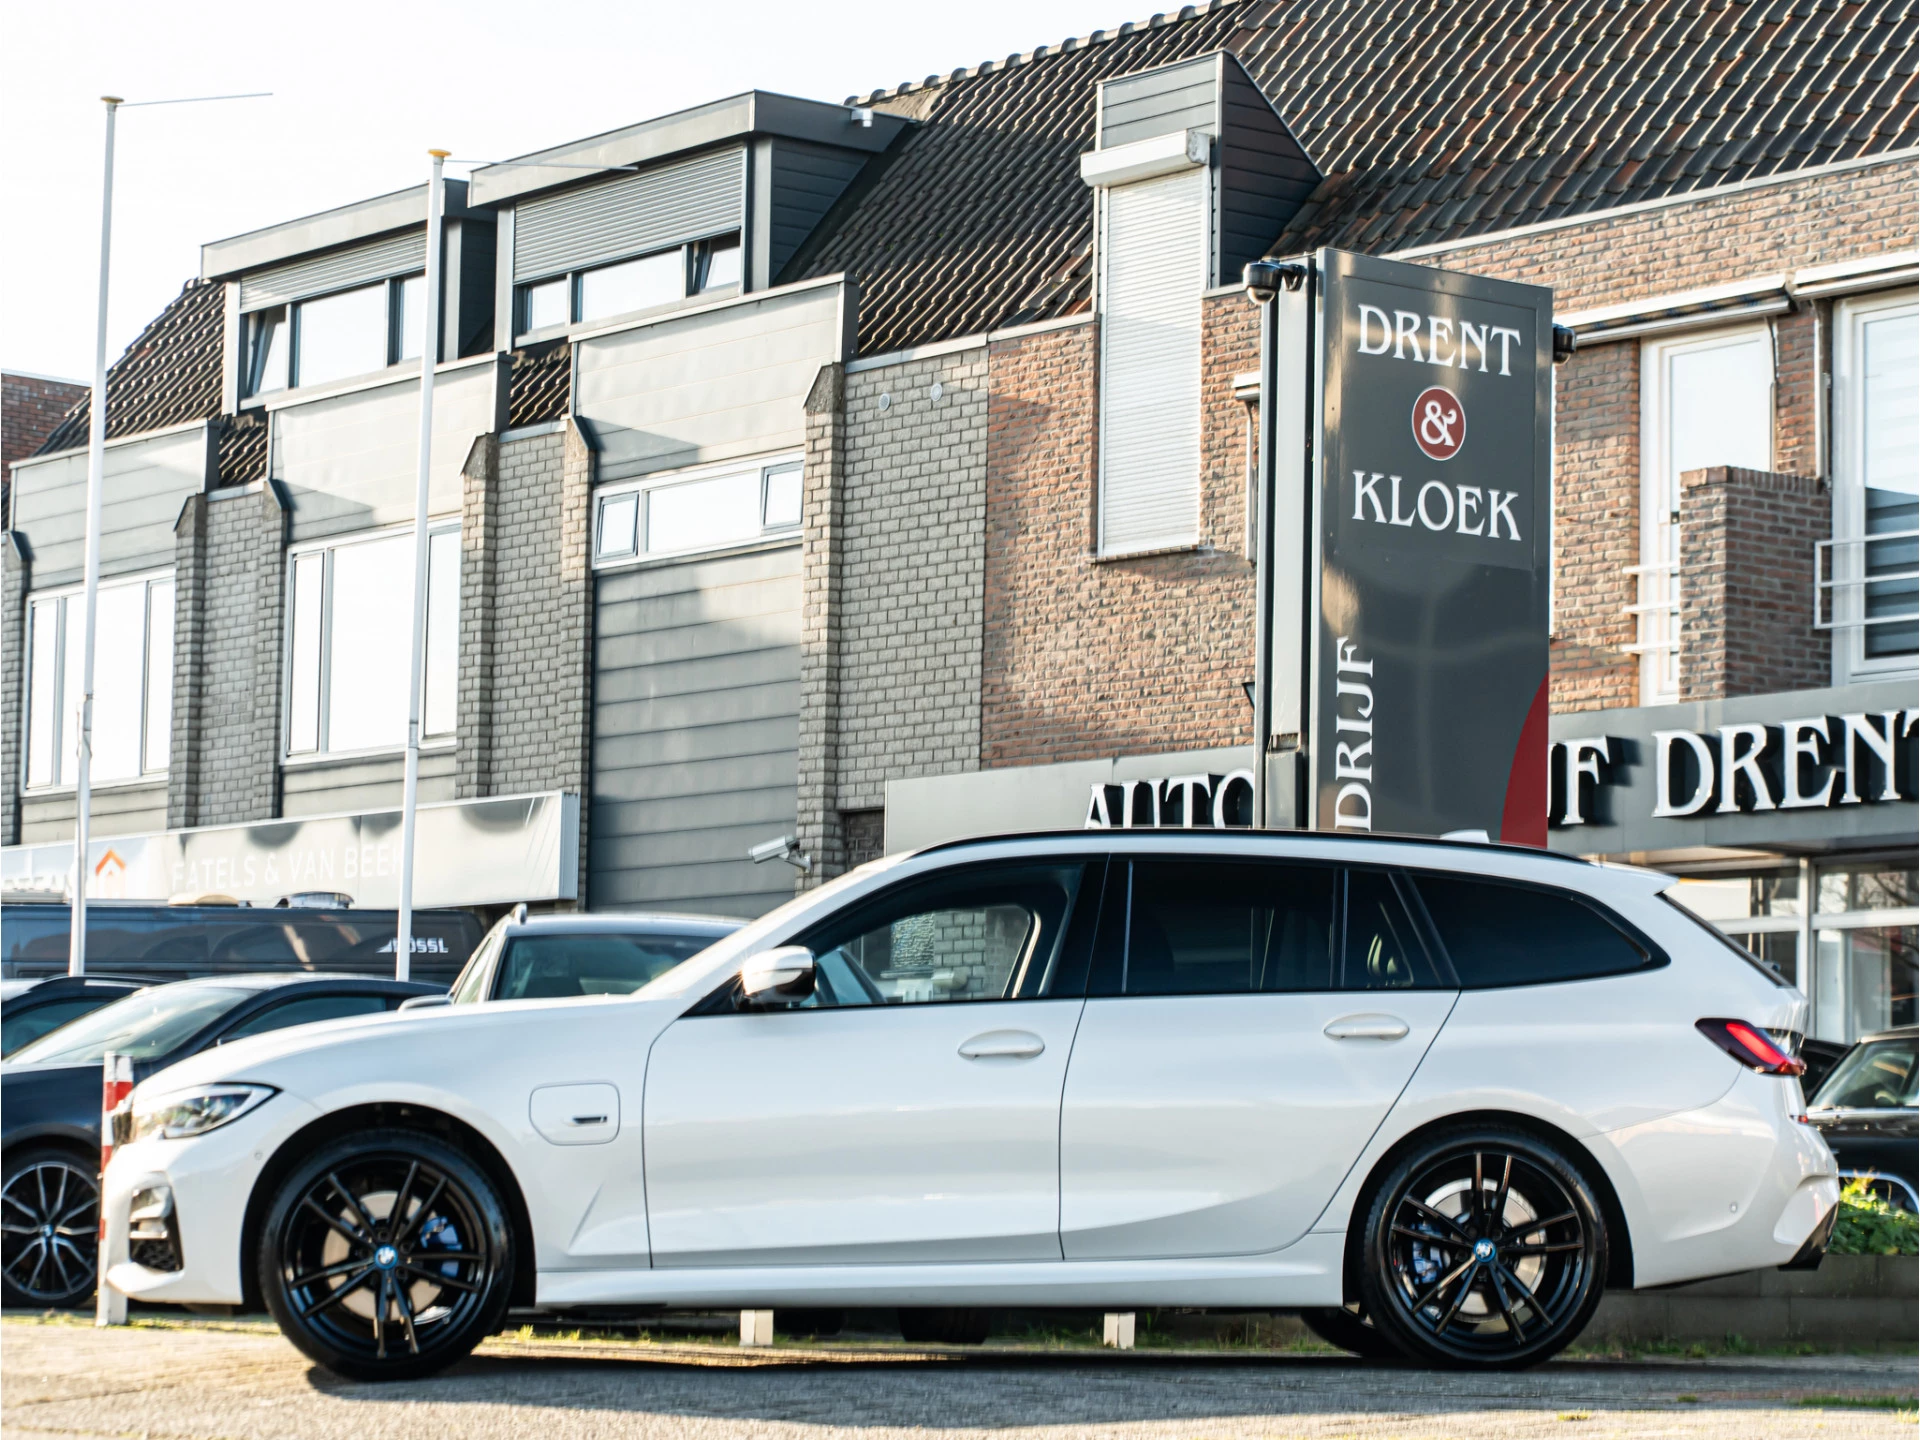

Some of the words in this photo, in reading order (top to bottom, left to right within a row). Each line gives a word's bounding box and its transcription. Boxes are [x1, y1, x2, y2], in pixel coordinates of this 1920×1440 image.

[1357, 303, 1521, 376] DRENT
[1421, 400, 1457, 447] &
[1352, 470, 1522, 541] KLOEK
[1335, 635, 1374, 832] DRIJF
[289, 847, 334, 882] VAN
